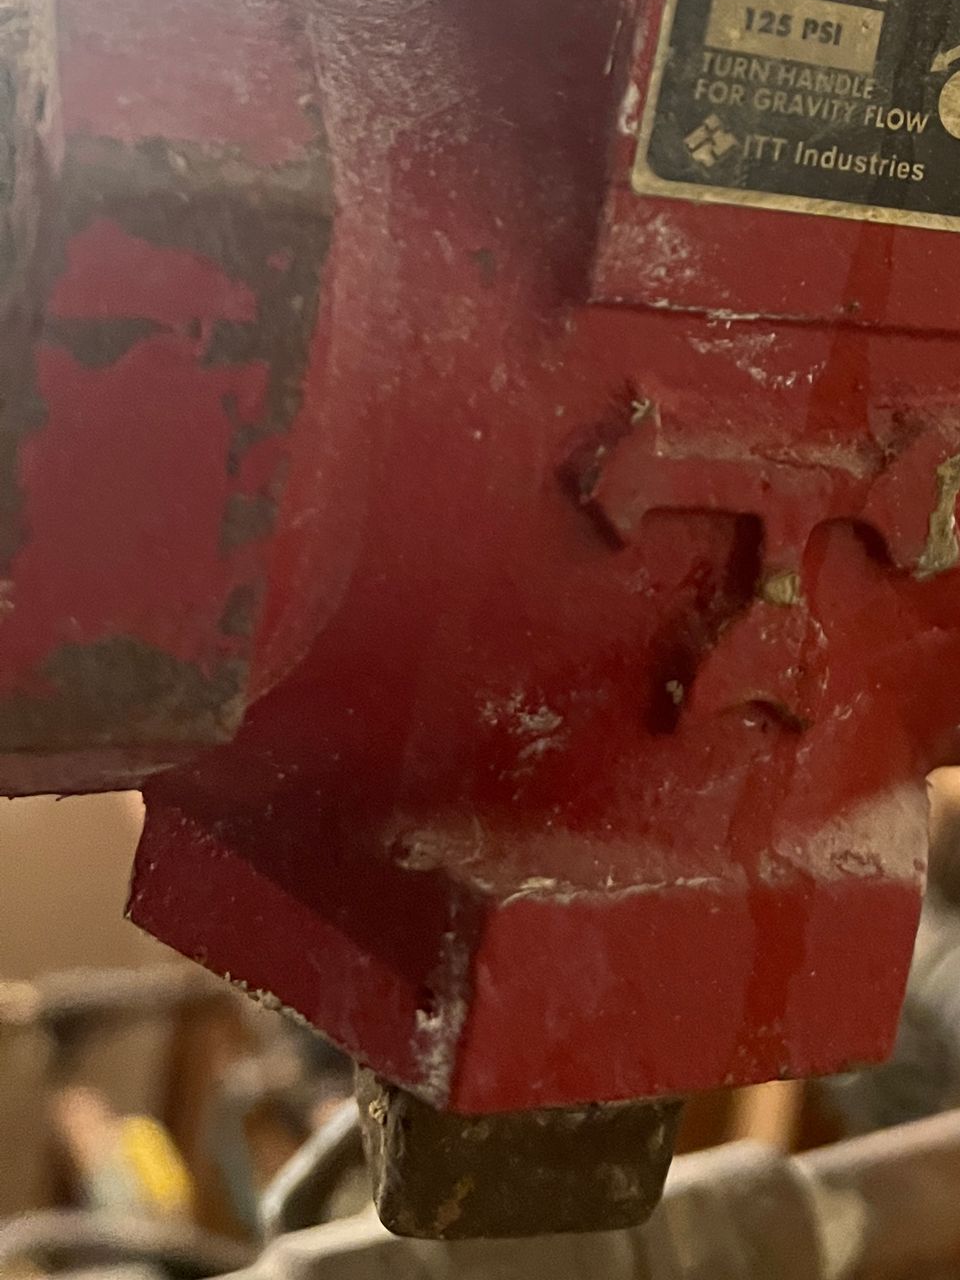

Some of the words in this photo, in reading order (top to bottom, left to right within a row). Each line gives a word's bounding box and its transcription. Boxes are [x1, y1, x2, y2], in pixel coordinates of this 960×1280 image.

[744, 7, 794, 38] 125
[801, 17, 843, 47] PSI
[700, 52, 770, 81] TURN
[777, 69, 877, 100] HANDLE
[694, 78, 745, 106] FOR
[752, 87, 855, 122] GRAVITY
[863, 105, 931, 135] FLOW
[743, 135, 788, 162] ITT
[794, 141, 926, 182] Industries
